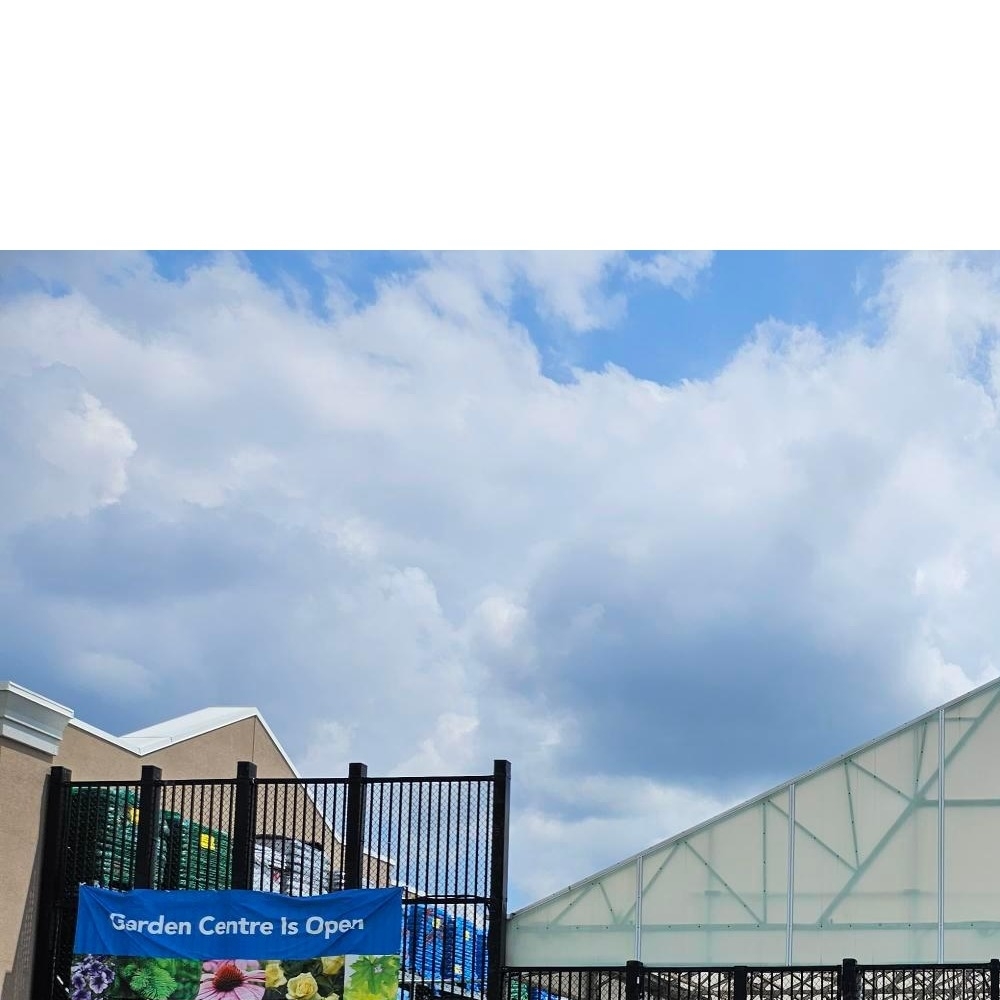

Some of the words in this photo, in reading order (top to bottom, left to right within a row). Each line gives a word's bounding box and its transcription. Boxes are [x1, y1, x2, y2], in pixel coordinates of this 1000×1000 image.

[110, 912, 192, 936] Garden
[199, 915, 274, 936] Centre
[281, 916, 299, 935] Is
[305, 916, 364, 940] Open
